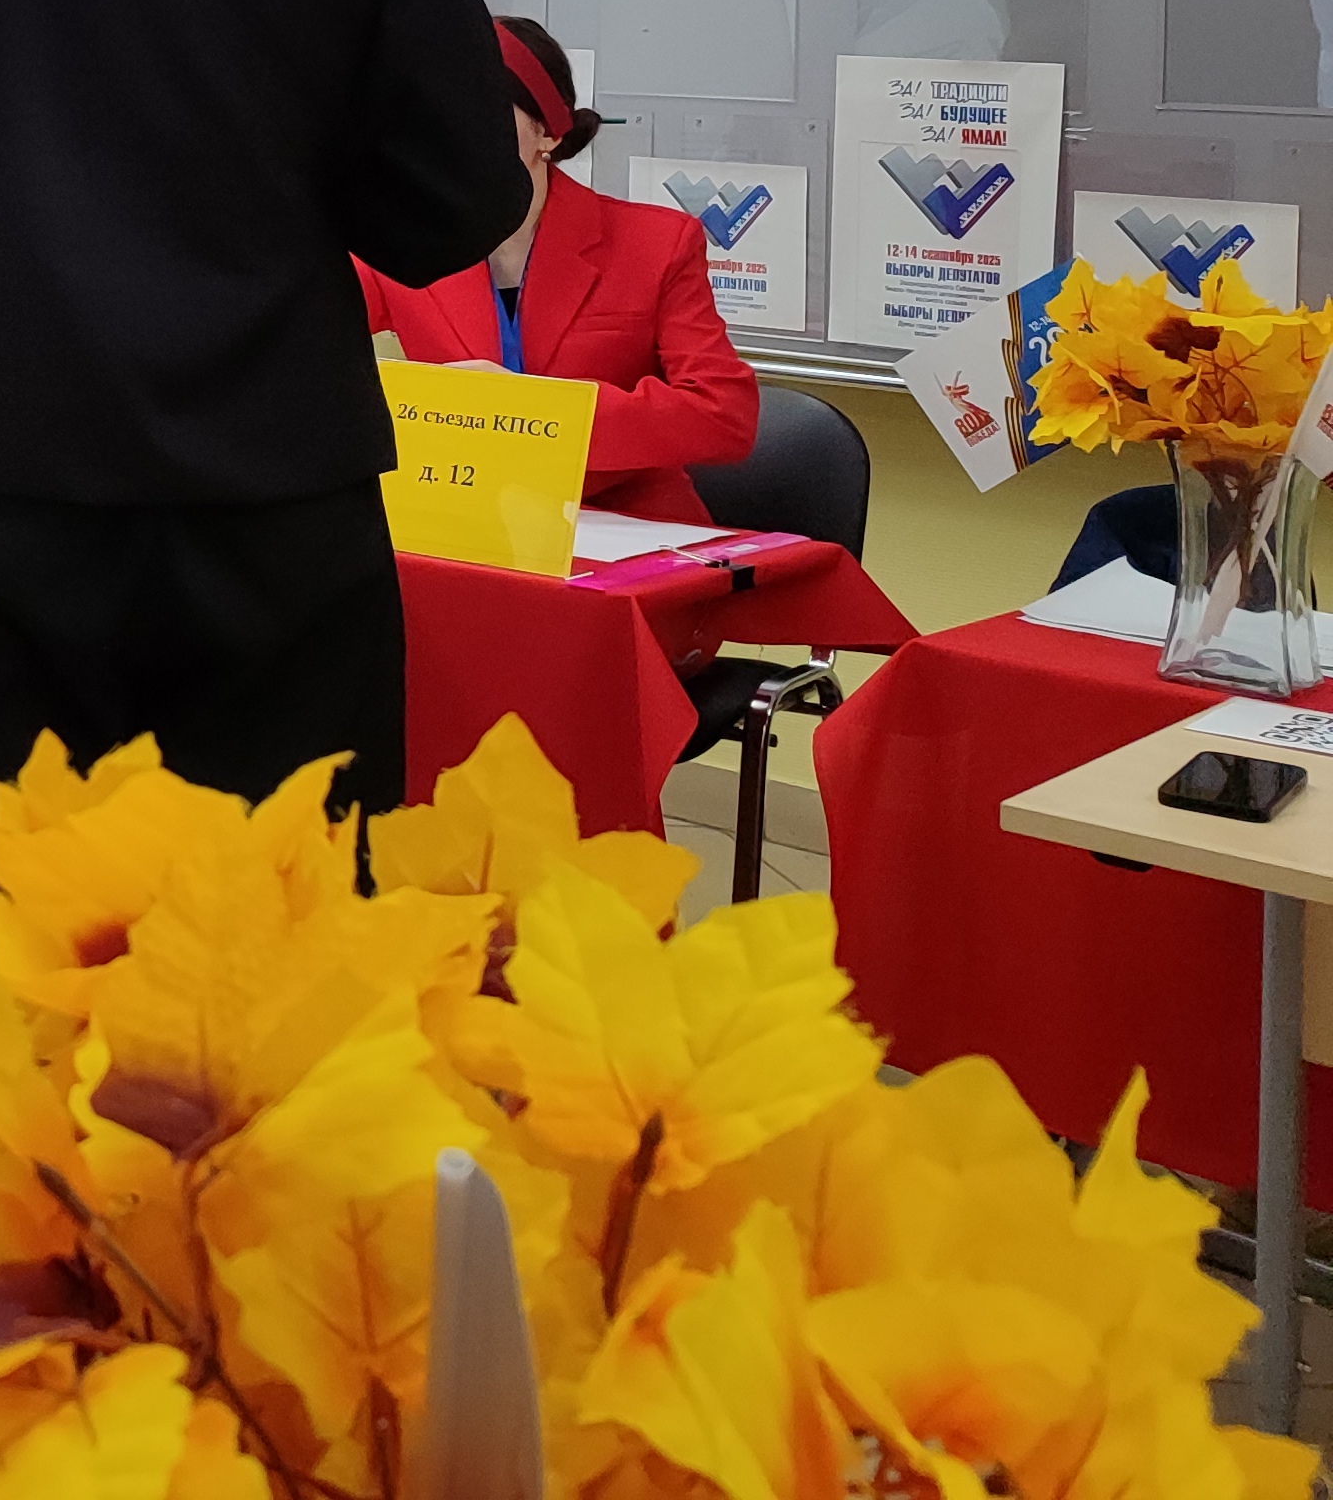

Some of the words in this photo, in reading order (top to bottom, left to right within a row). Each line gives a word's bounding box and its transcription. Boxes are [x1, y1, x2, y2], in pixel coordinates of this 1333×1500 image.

[888, 79, 922, 98] ЗА!
[931, 81, 1009, 104] ТРАДИЦИИ
[899, 103, 933, 120] ЗА!
[940, 105, 1008, 126] БУДУЩЕЕ
[921, 126, 955, 144] ЗА!
[961, 128, 1008, 147] ЯМАЛ!
[887, 243, 918, 259] 12-14
[977, 253, 1001, 266] 2025
[746, 262, 767, 274] 2025
[885, 262, 934, 279] ВЫБОРЫ
[937, 267, 1001, 285] ДЕПУТАТОВ
[711, 275, 767, 293] ДЕПУТАТОВ
[884, 303, 933, 321] ВЫБОРЫ
[396, 403, 418, 421] 26
[423, 410, 486, 430] съезда
[492, 414, 560, 439] КПСС
[418, 465, 439, 485] д.
[449, 464, 475, 487] 12
